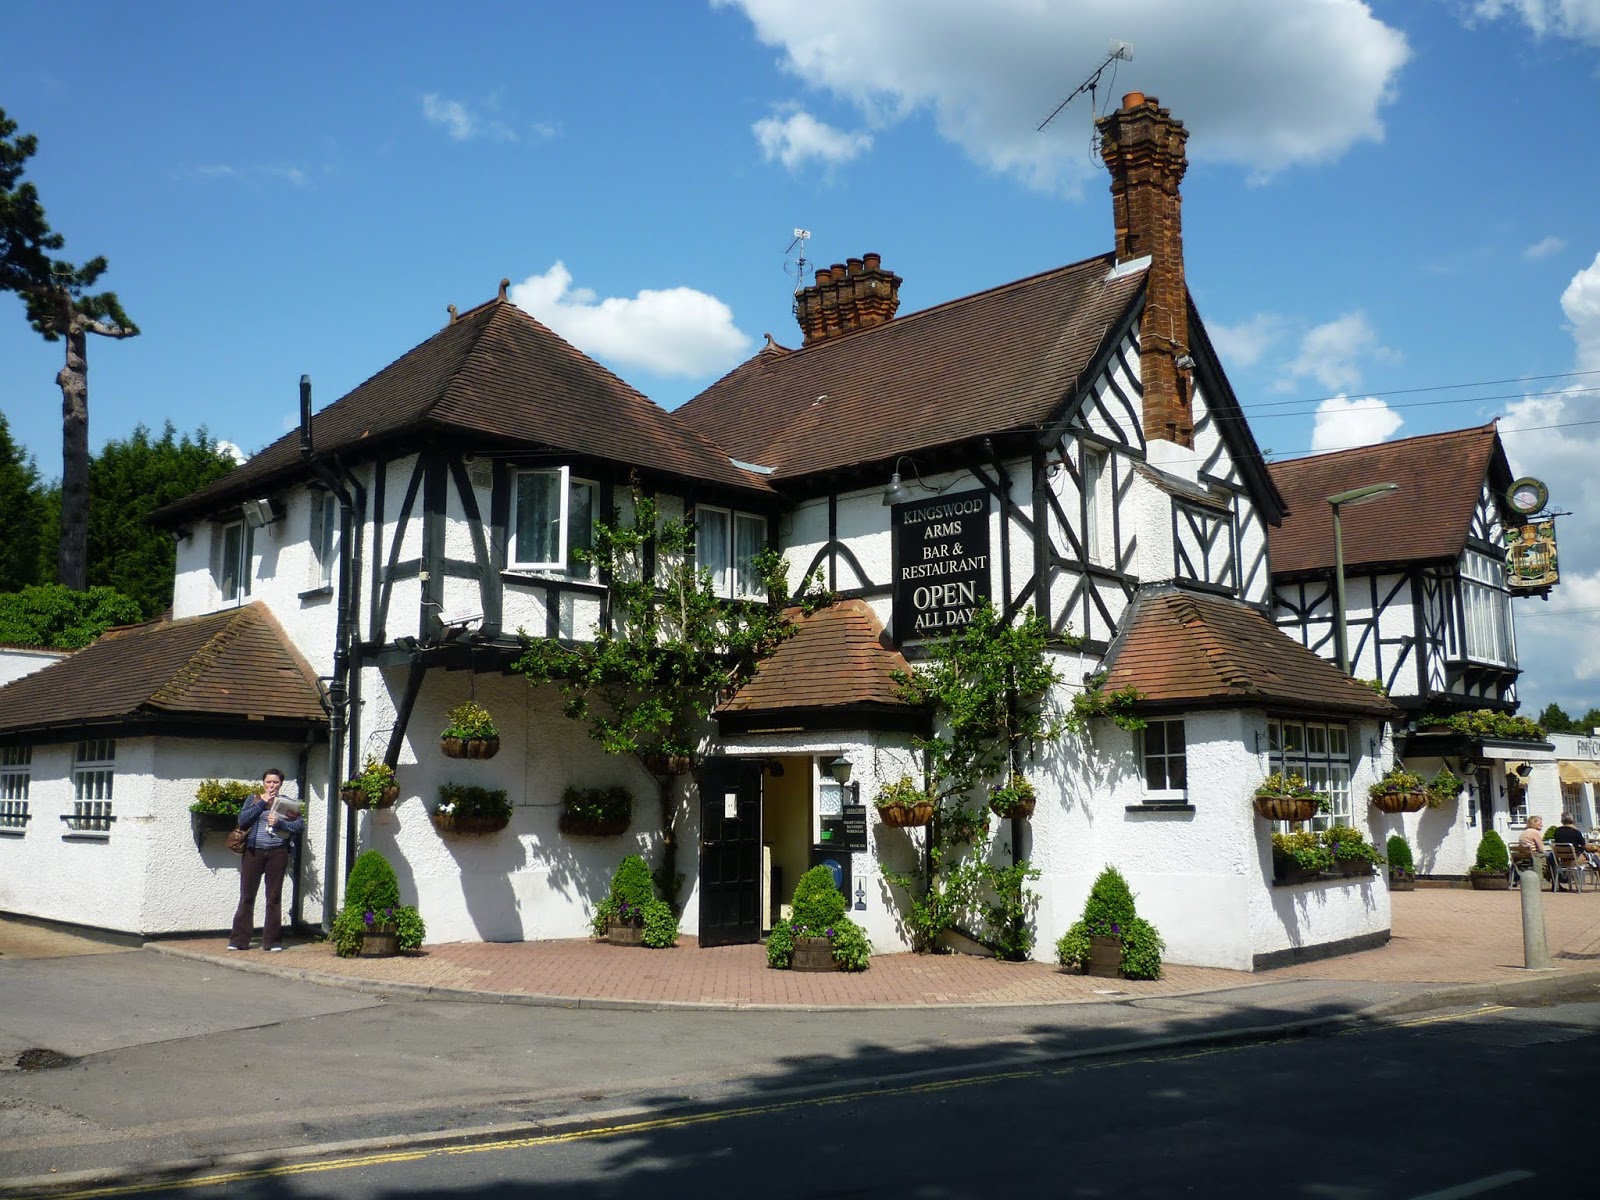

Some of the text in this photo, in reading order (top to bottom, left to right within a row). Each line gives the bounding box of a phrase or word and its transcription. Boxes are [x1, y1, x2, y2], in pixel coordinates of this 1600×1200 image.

[904, 499, 983, 525] KINGSWOOD
[924, 521, 963, 540] ARMS
[922, 541, 964, 560] BAR &
[902, 556, 987, 580] RESTAURANT
[913, 580, 977, 611] OPEN
[914, 607, 977, 629] ALL DAY
